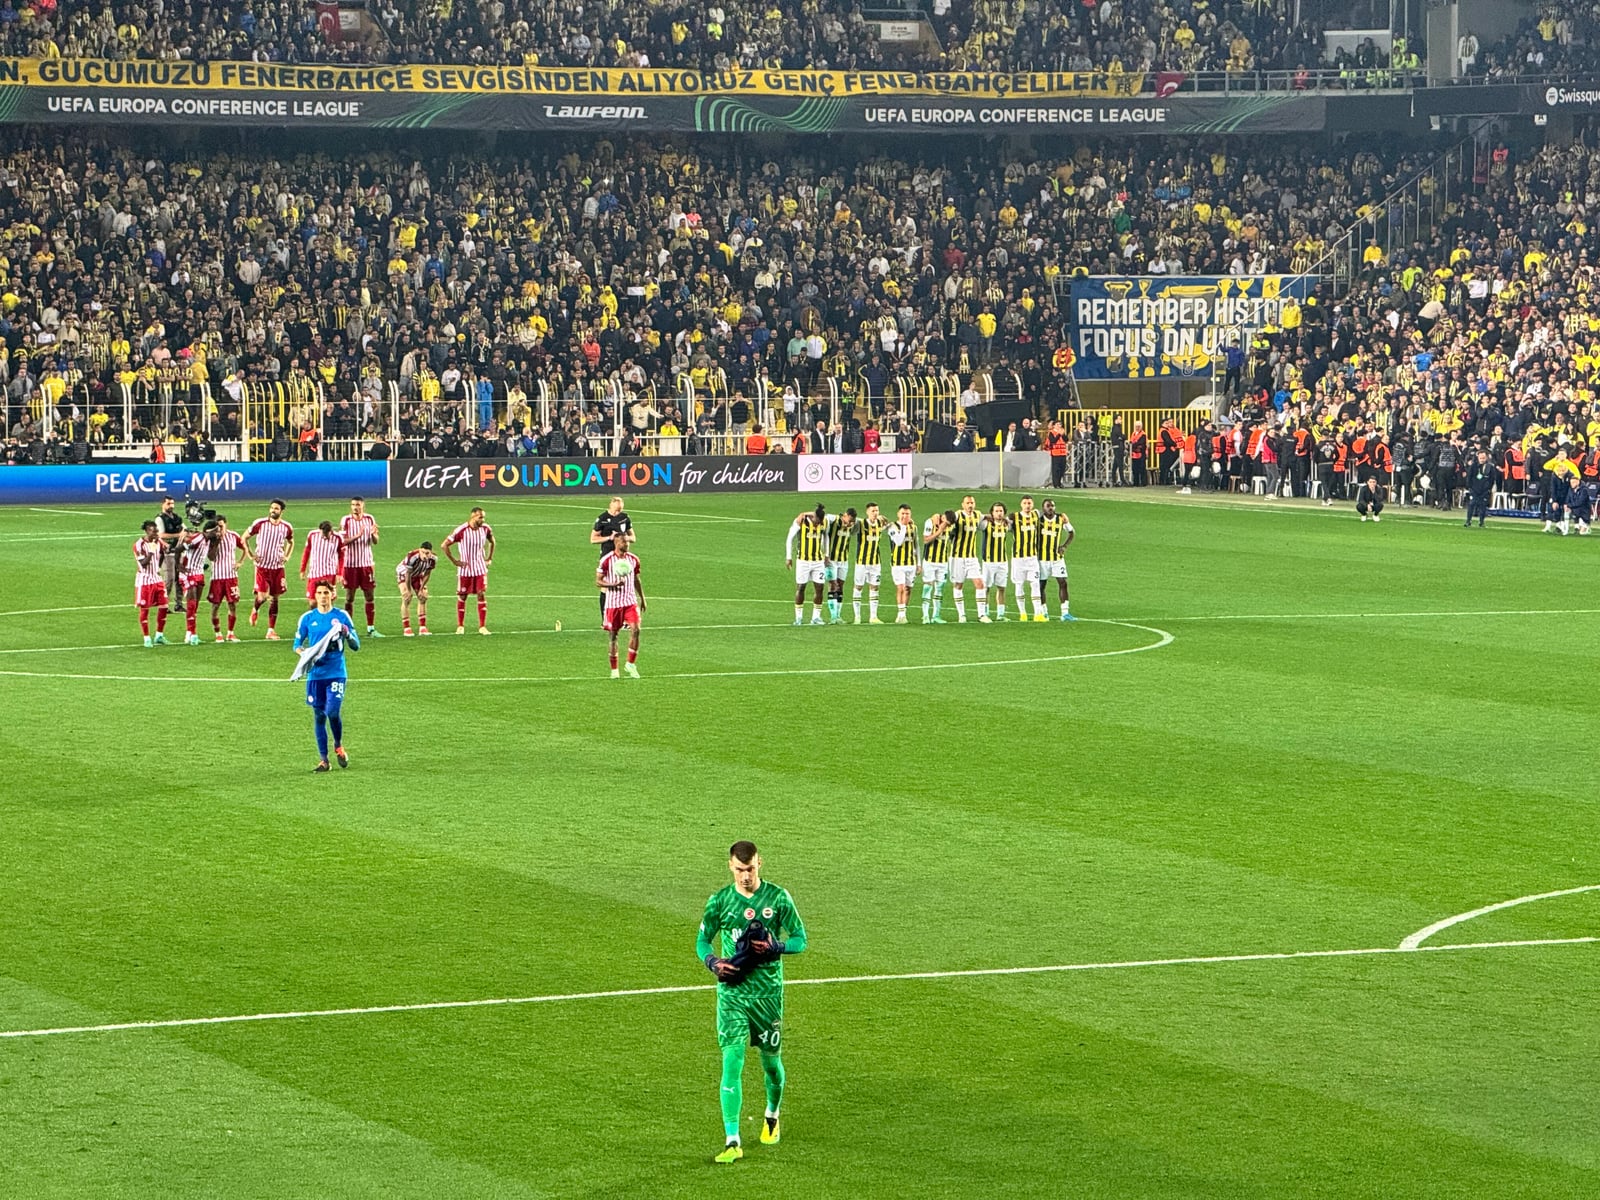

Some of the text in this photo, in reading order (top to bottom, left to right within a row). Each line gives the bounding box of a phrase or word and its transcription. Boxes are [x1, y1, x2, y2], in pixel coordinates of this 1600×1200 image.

[221, 64, 414, 92] FENERBAHÇE
[618, 71, 756, 92] ALIYORUZ
[764, 73, 836, 97] GENÇ
[47, 97, 359, 117] UEFA EUROPA CONFERENCE LEAGUE
[865, 108, 1166, 123] UEFA EUROPA CONFERENCE LEAGUE
[1078, 297, 1207, 325] REMEMBER
[1079, 327, 1156, 358] FOCUS
[1163, 327, 1196, 357] ON
[404, 461, 785, 494] UEFA FOUNDATION for children
[830, 463, 908, 481] RESPECT
[95, 472, 167, 493] PEACE
[331, 681, 344, 694] 88
[758, 1030, 780, 1047] 40
